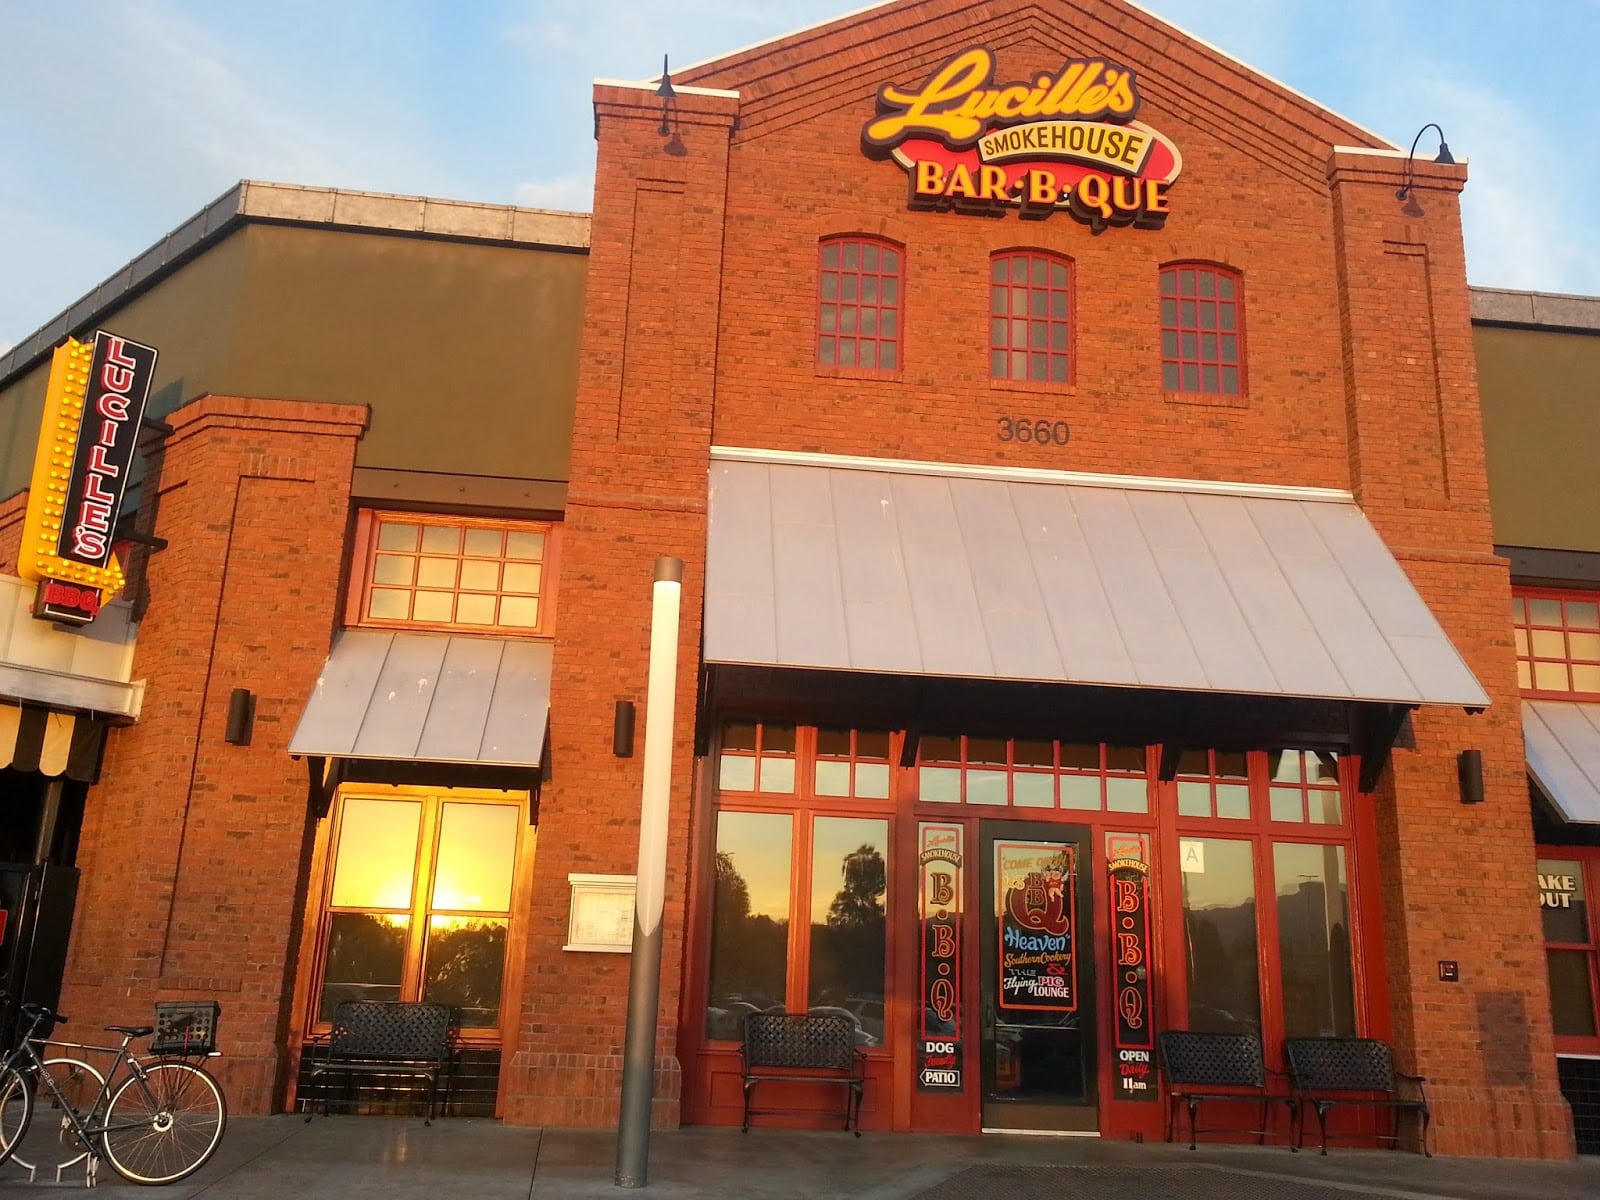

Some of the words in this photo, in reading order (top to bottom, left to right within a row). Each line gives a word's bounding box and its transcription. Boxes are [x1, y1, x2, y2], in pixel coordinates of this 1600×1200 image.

[866, 47, 1135, 140] Lucille's
[983, 125, 1145, 166] SMOKEHOUSE
[997, 416, 1070, 446] 3660
[71, 336, 137, 560] LUCILLE'S
[44, 583, 100, 616] BBQ
[1186, 846, 1198, 862] A
[1004, 952, 1040, 968] Southern
[1003, 976, 1038, 995] Flying
[1038, 976, 1064, 987] PIG
[1034, 986, 1070, 998] LOUNGE
[925, 1041, 955, 1054] DOG
[1119, 1049, 1150, 1062] OPEN
[925, 1071, 956, 1084] PATIO
